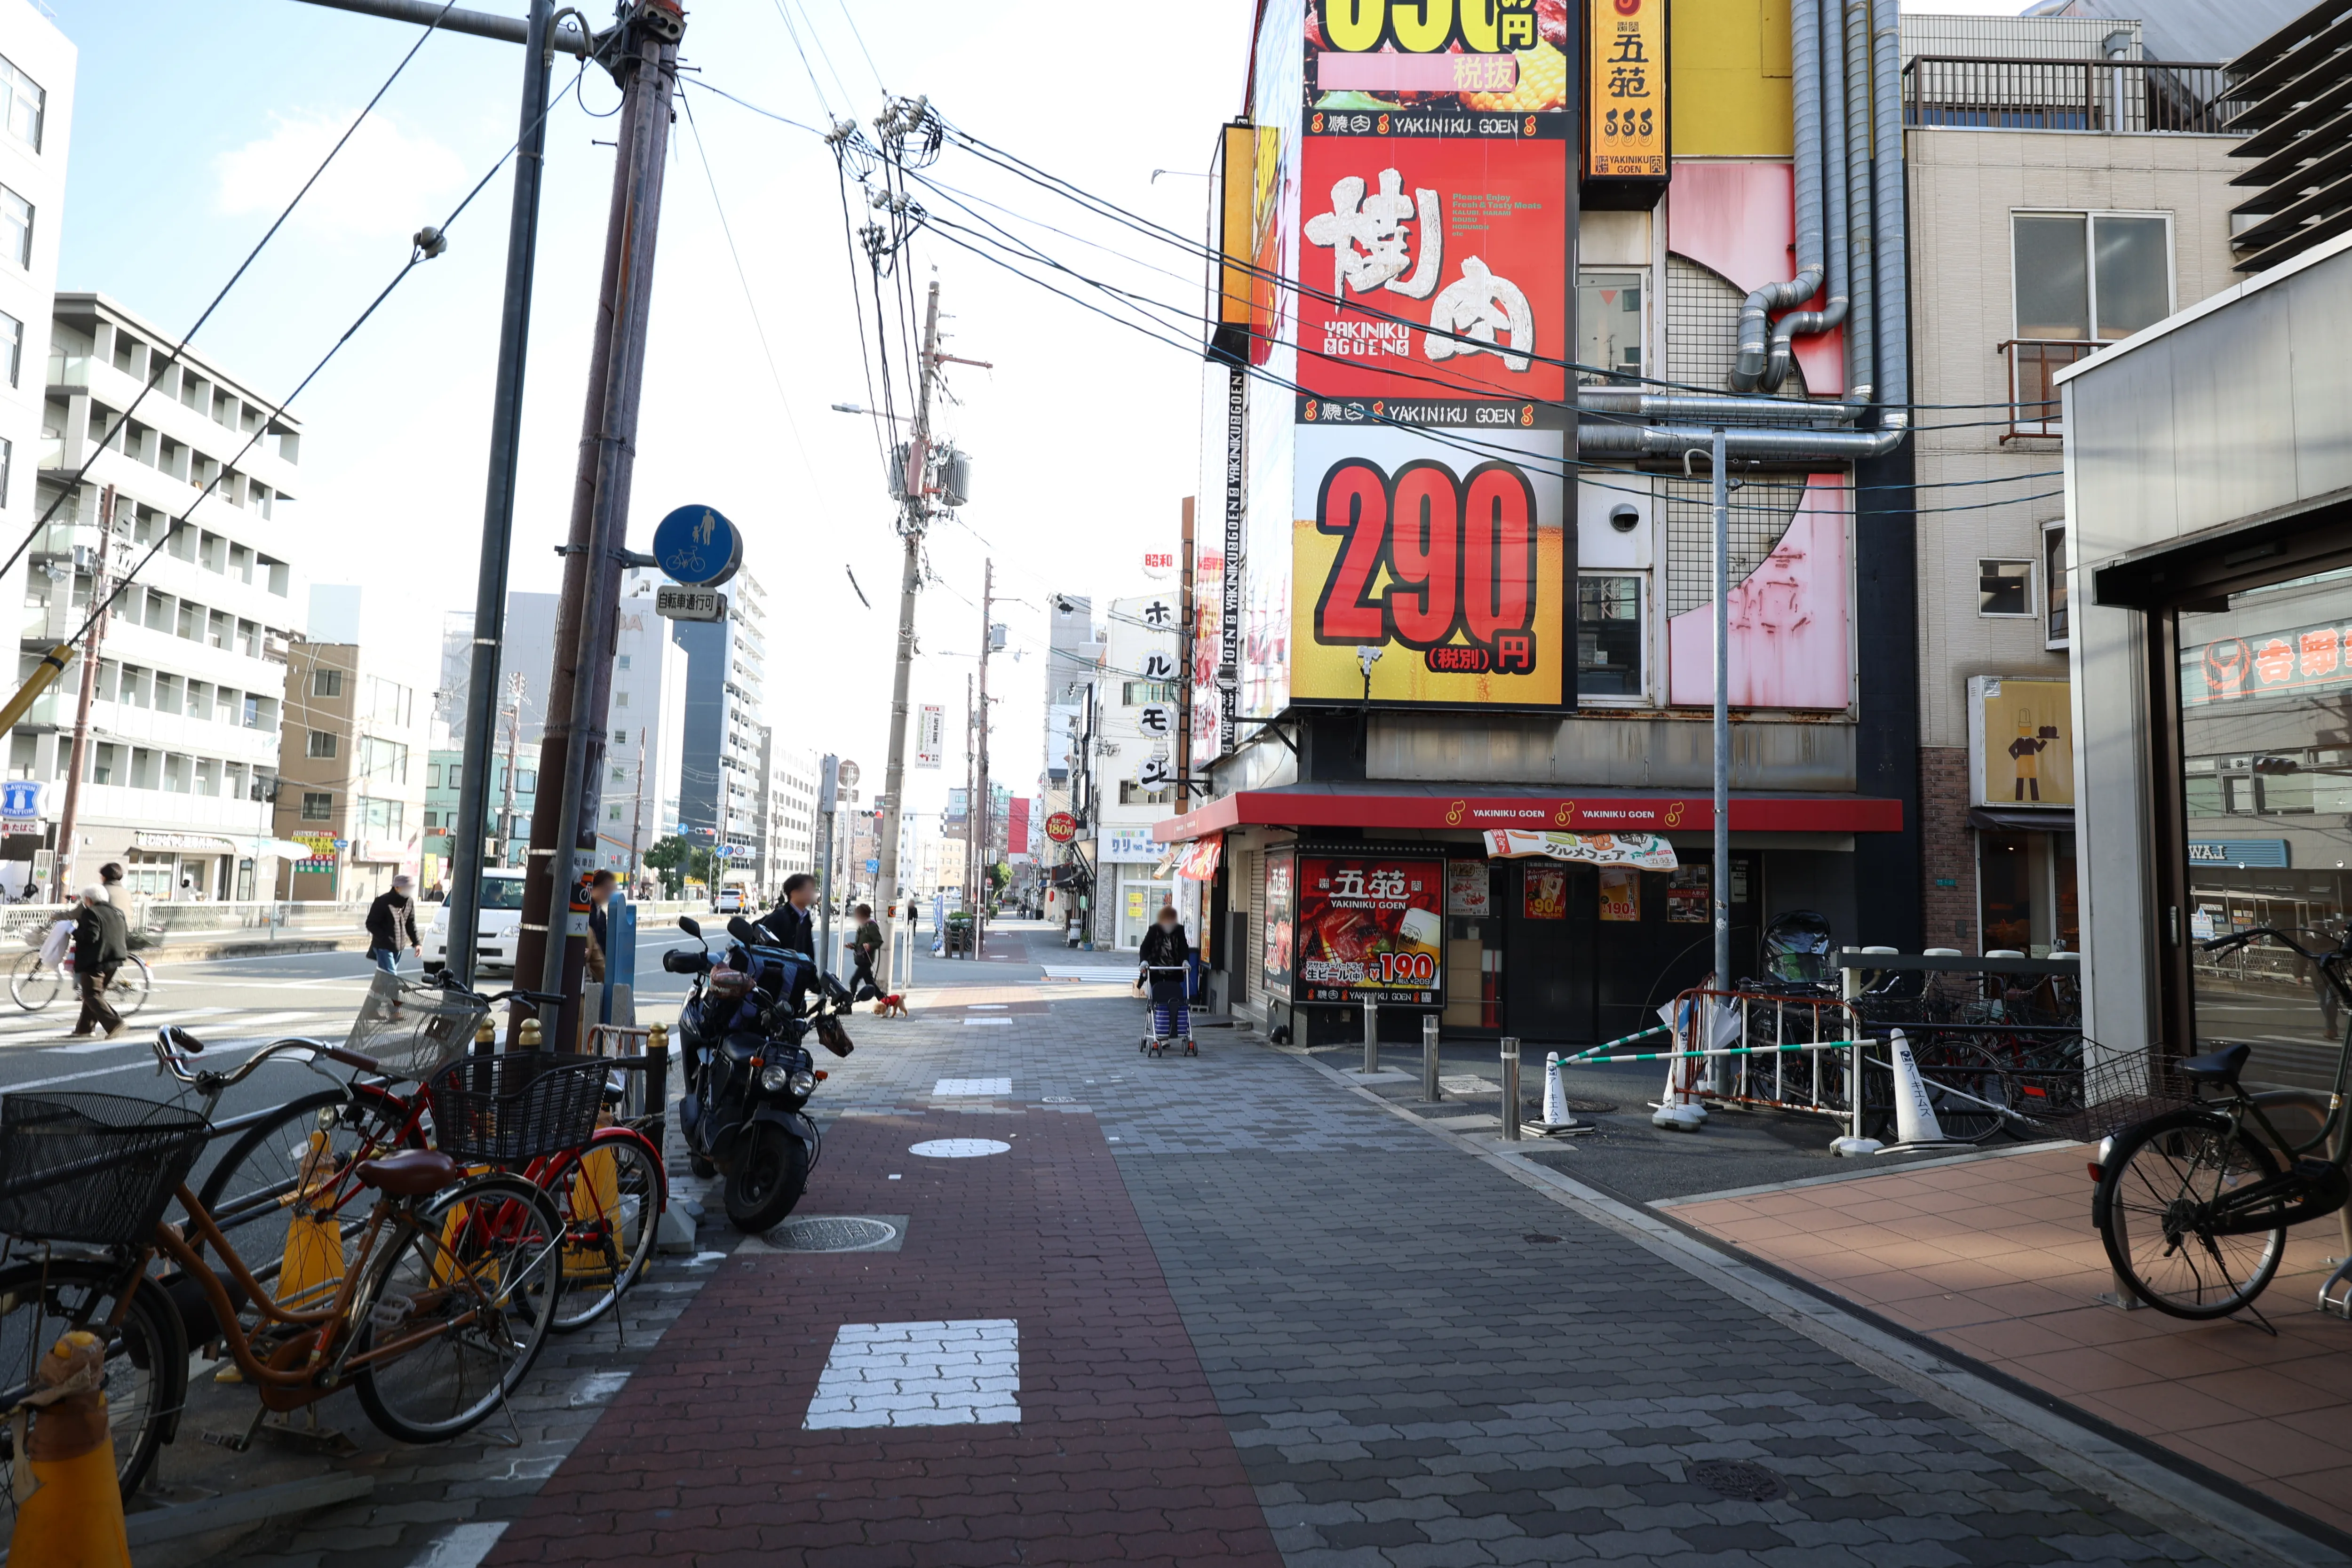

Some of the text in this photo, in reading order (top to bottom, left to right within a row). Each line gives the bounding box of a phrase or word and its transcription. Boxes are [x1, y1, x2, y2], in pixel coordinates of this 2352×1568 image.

[1453, 57, 1514, 89] 税抜
[1607, 34, 1651, 97] 五苑
[1395, 118, 1518, 135] YAKINIKU GOEN
[1609, 156, 1649, 164] YAKINIKU
[1617, 165, 1641, 174] GOEN
[1324, 321, 1409, 339] YAKINIKU
[1338, 340, 1397, 356] GOEN
[1390, 406, 1516, 424] YAKINIKU GOEN
[1229, 376, 1243, 483] YAKINIKU GOEN
[1145, 553, 1173, 567] 昭和
[1226, 501, 1239, 610] YAKINIKU GOEN
[658, 592, 715, 612] 自転車通行可
[1429, 647, 1490, 670] (税別)
[1473, 809, 1516, 818] YAKINIKU
[1582, 810, 1626, 819] YAKINIKU
[1544, 843, 1626, 861] グルメフェア
[1271, 867, 1287, 896] 五苑
[1328, 869, 1410, 899] 五苑
[1331, 900, 1376, 909] YAKINIKU
[1307, 961, 1364, 969] アサヒスーパードライ
[1349, 991, 1388, 1001] YAKKU
[1391, 992, 1412, 1001] GOEN
[1904, 1063, 1932, 1117] アーキエムズ
[1548, 1077, 1560, 1124] アーキエムズ
